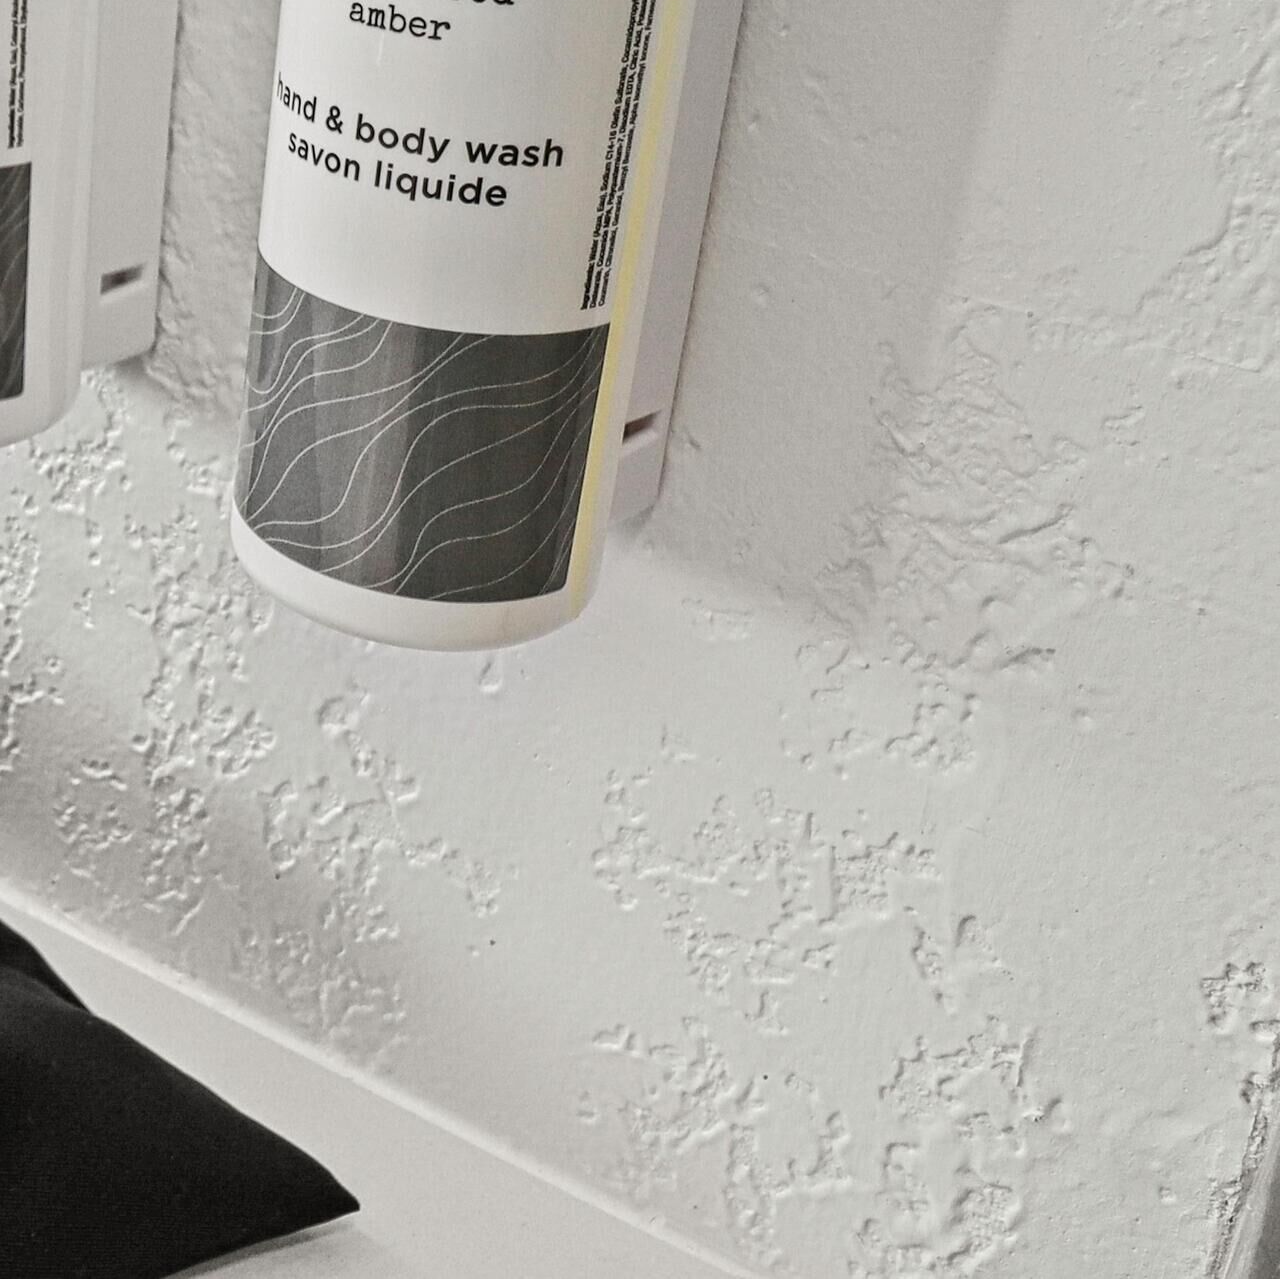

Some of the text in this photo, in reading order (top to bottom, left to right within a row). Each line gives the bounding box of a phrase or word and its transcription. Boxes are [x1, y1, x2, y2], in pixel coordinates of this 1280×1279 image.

[348, 1, 452, 41] amber
[276, 71, 564, 168] hand & body wash
[287, 131, 508, 207] savon liquide
